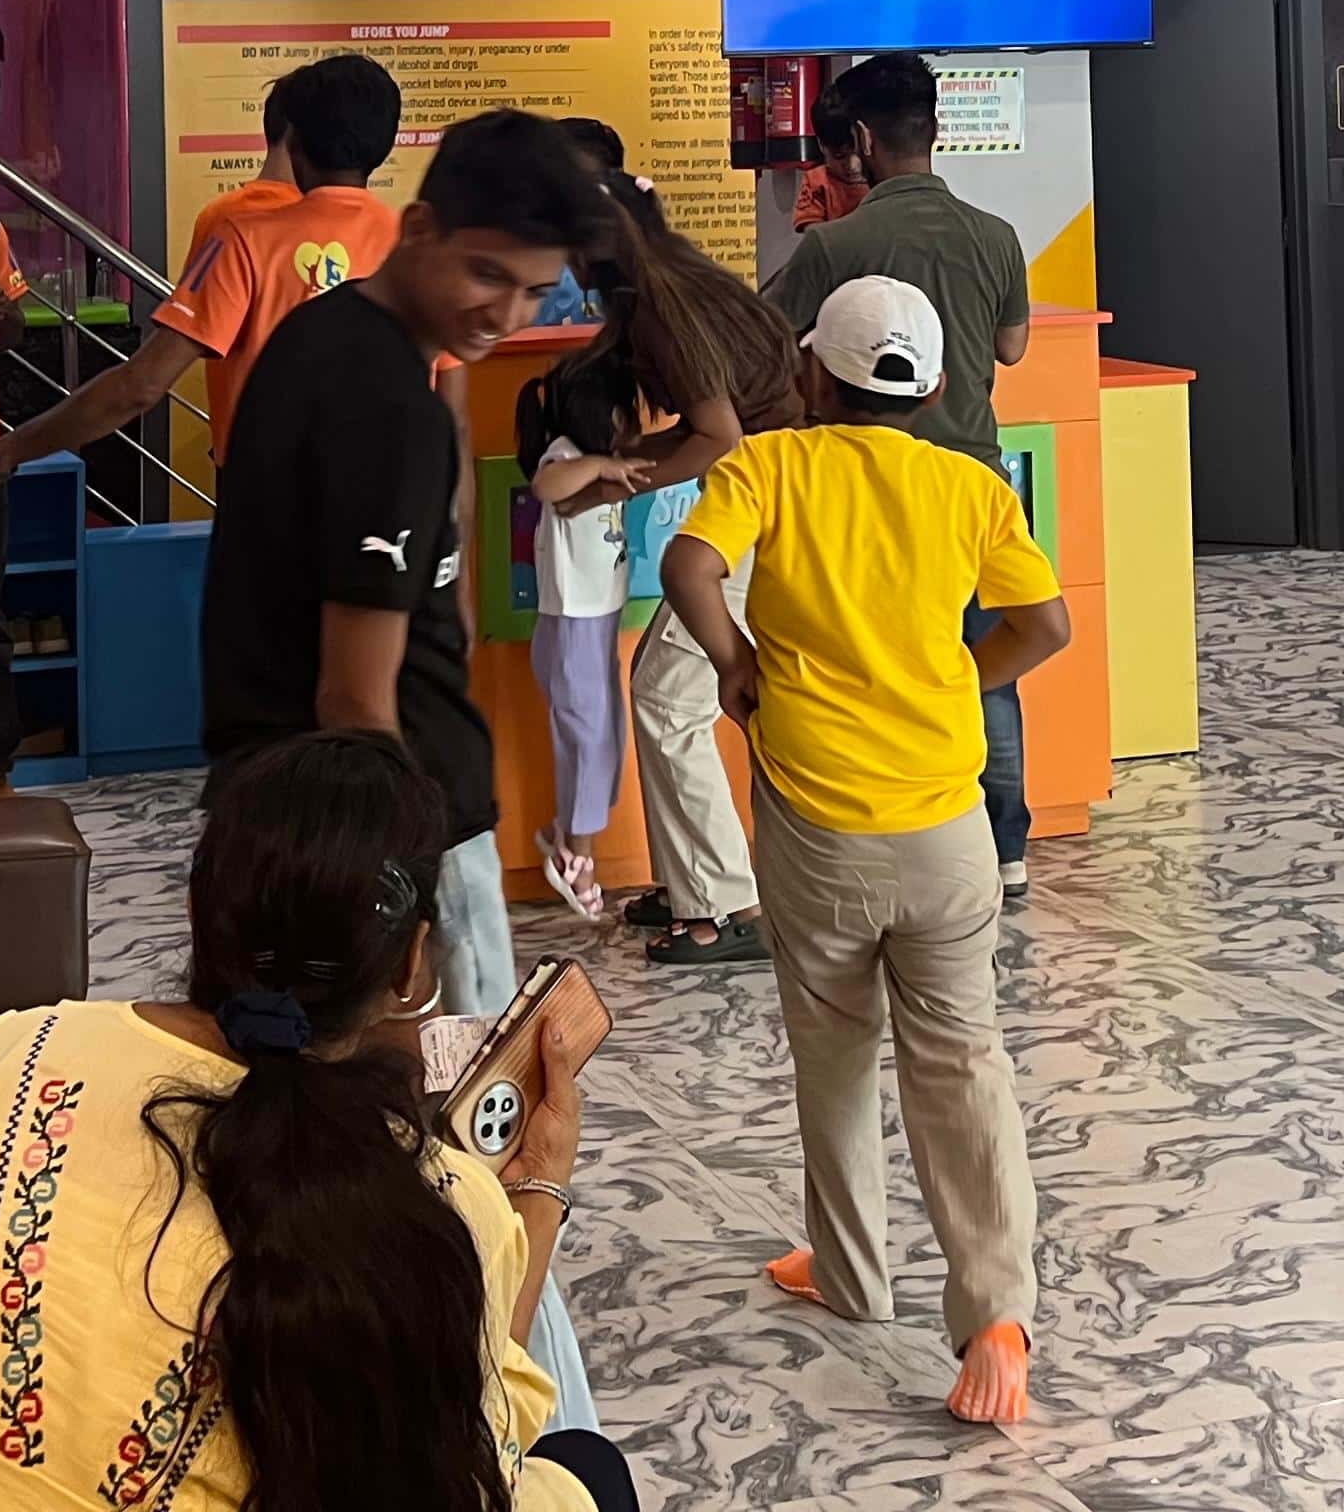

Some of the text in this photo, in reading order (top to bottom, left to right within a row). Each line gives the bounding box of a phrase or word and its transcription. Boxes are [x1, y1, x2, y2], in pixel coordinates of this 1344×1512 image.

[351, 26, 449, 38] BEFORE YOU JUMP
[659, 29, 681, 38] order
[684, 29, 696, 38] for
[242, 47, 256, 58] DO
[260, 47, 280, 57] NOT
[283, 47, 310, 58] Jump
[546, 44, 570, 53] under
[433, 60, 449, 70] and
[452, 60, 478, 71] drugs
[650, 59, 690, 70] Everyone
[692, 59, 710, 67] who
[683, 71, 708, 80] Those
[434, 78, 462, 88] before
[464, 80, 482, 89] you
[448, 96, 477, 107] device
[673, 98, 690, 107] time
[211, 159, 254, 170] ALWAYS
[718, 191, 745, 199] courts
[684, 206, 700, 216] you
